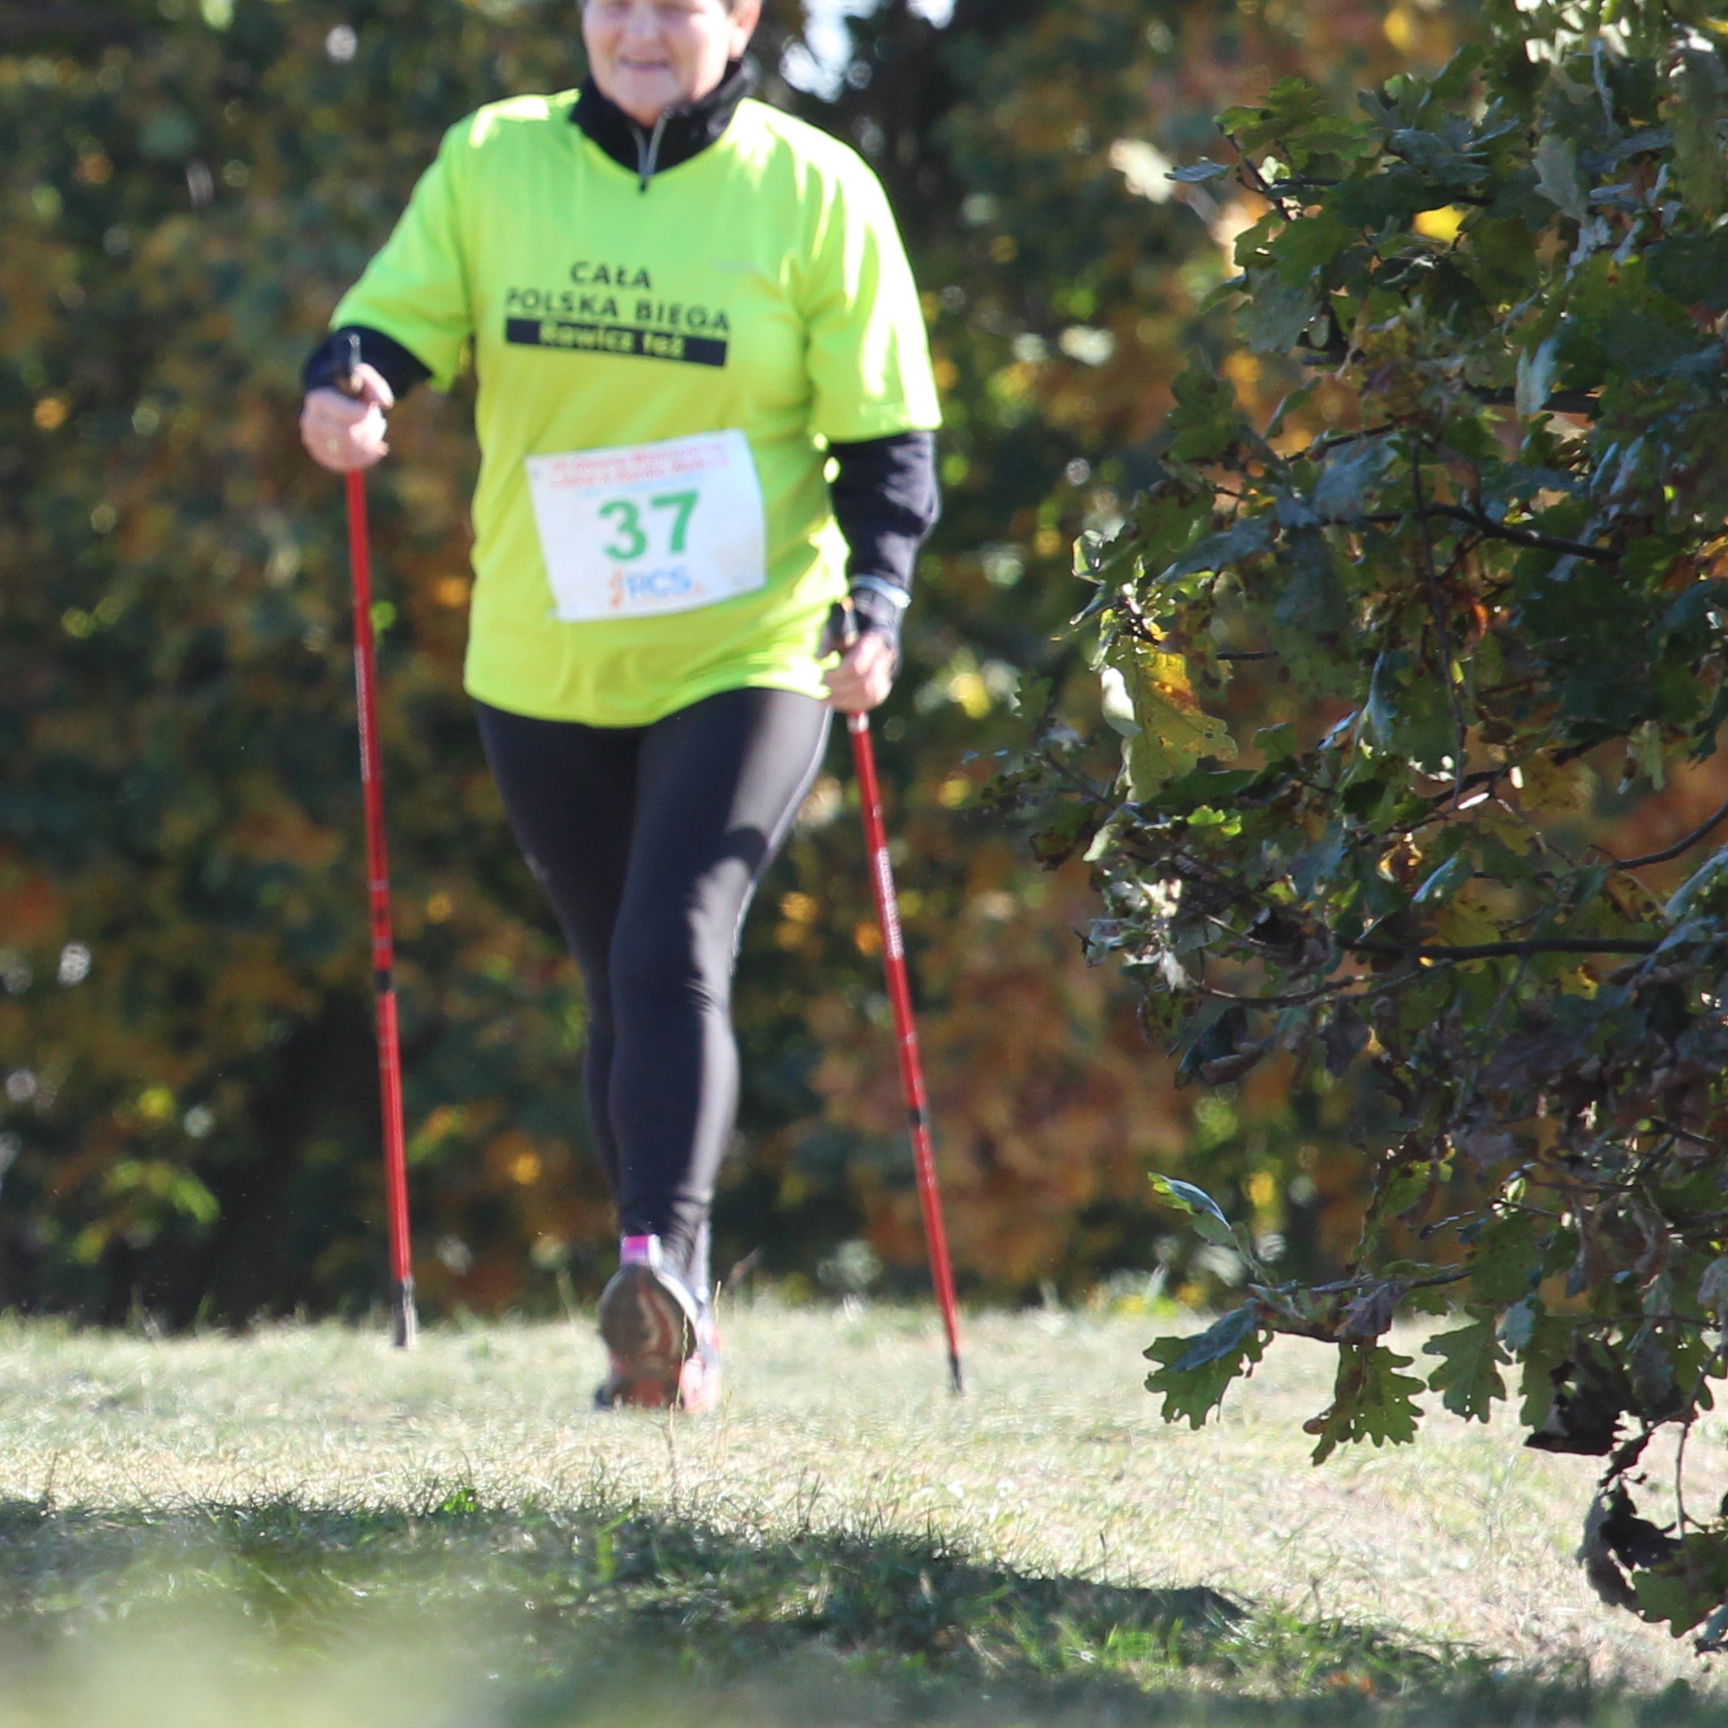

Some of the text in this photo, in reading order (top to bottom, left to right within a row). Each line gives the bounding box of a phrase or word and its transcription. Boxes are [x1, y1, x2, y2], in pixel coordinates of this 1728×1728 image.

[570, 261, 651, 290] CAŁA
[506, 287, 729, 332] POLSKA BIEGA
[599, 490, 699, 562] 37
